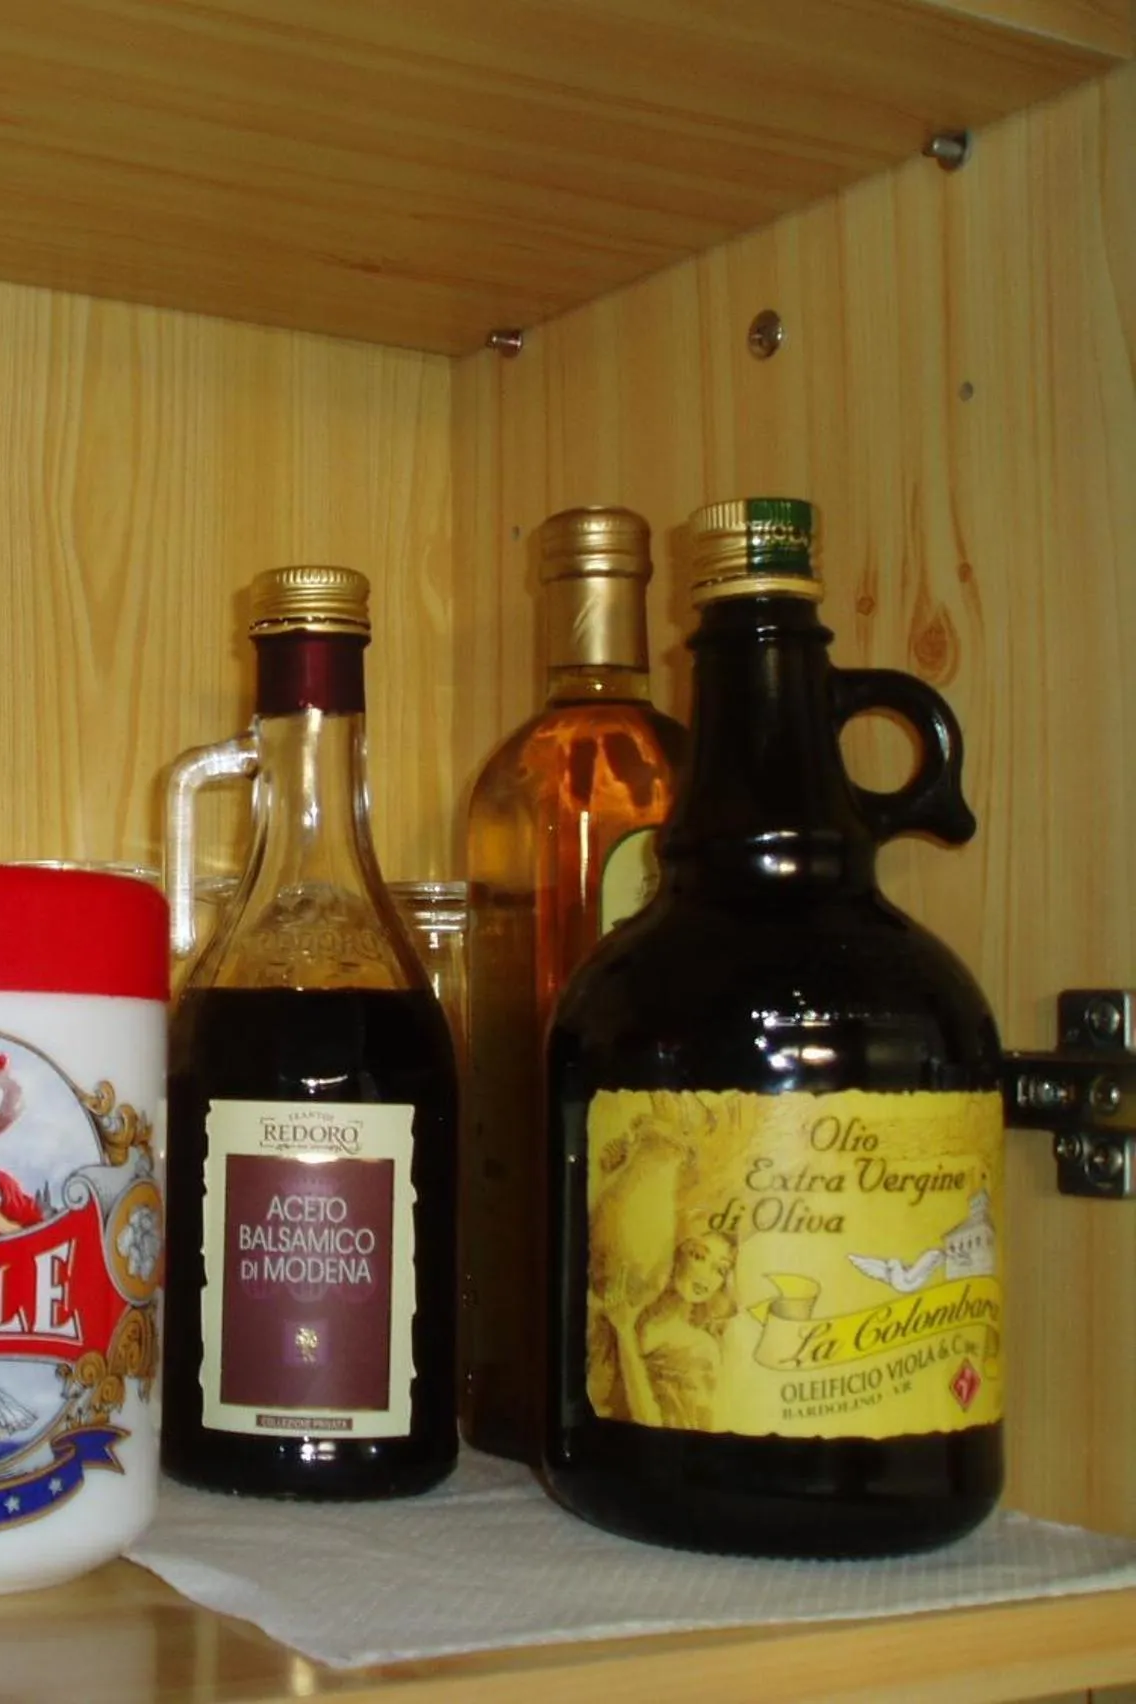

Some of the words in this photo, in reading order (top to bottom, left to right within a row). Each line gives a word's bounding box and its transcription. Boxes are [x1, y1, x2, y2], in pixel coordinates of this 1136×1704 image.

[263, 1123, 362, 1153] REDORO
[810, 1116, 880, 1151] Olio
[745, 1157, 846, 1193] Extra
[855, 1157, 966, 1207] Vergine
[267, 1195, 347, 1223] ACETO
[708, 1198, 746, 1232] di
[752, 1197, 846, 1234] Oliva
[239, 1224, 375, 1255] BALSAMICO
[241, 1261, 259, 1281] DI
[264, 1258, 372, 1284] MODENA
[780, 1367, 883, 1404] OLEIFICIO
[886, 1345, 936, 1381] VIOLA
